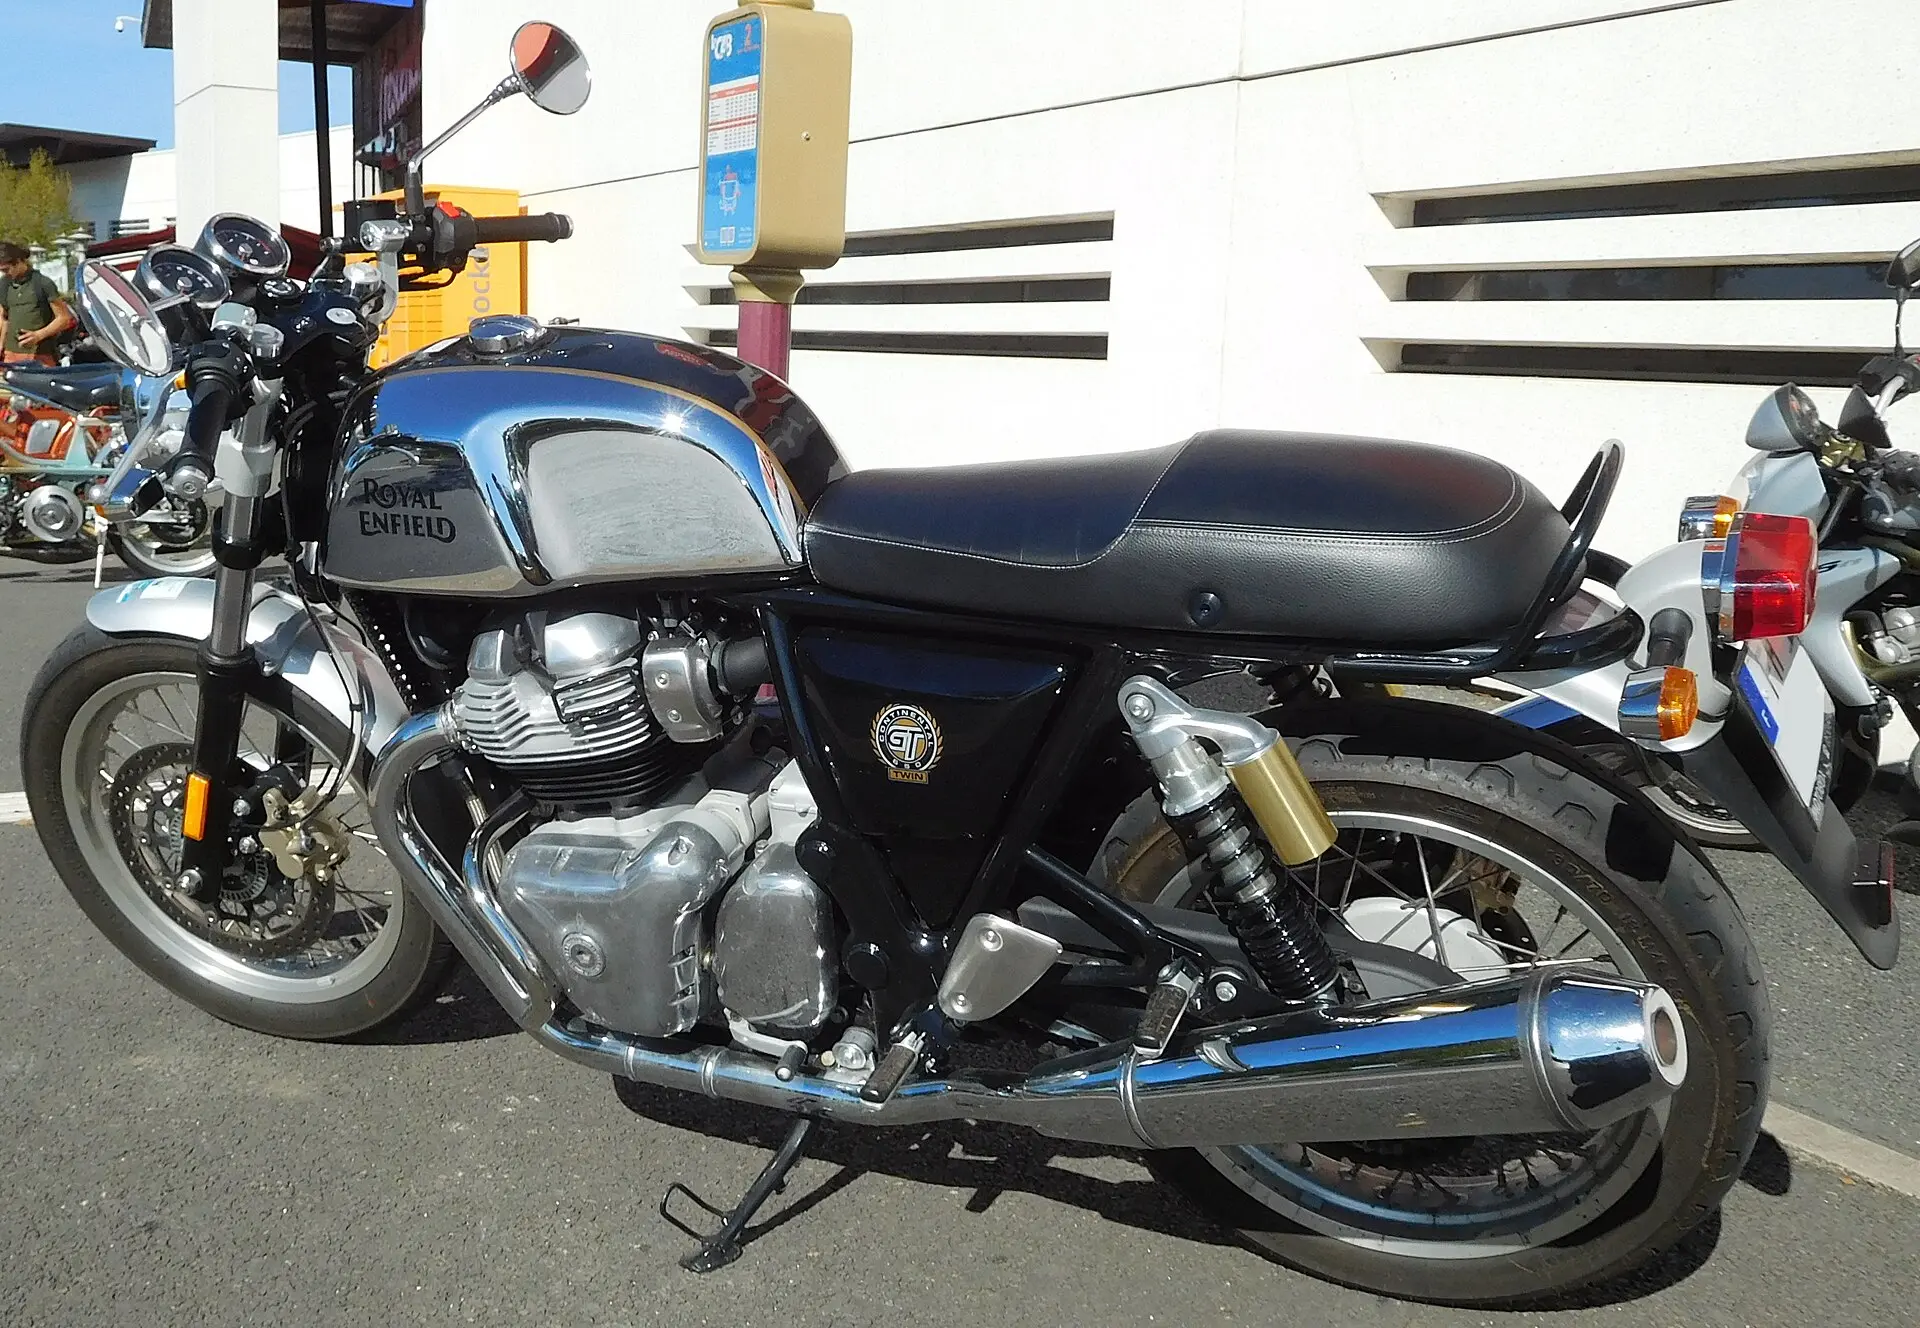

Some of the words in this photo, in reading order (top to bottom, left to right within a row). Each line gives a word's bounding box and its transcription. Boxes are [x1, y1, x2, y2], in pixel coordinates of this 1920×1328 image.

[358, 510, 457, 544] ENFIELD
[879, 709, 935, 748] CONTINENTAL
[886, 725, 926, 761] GT
[893, 770, 925, 781] TWIN
